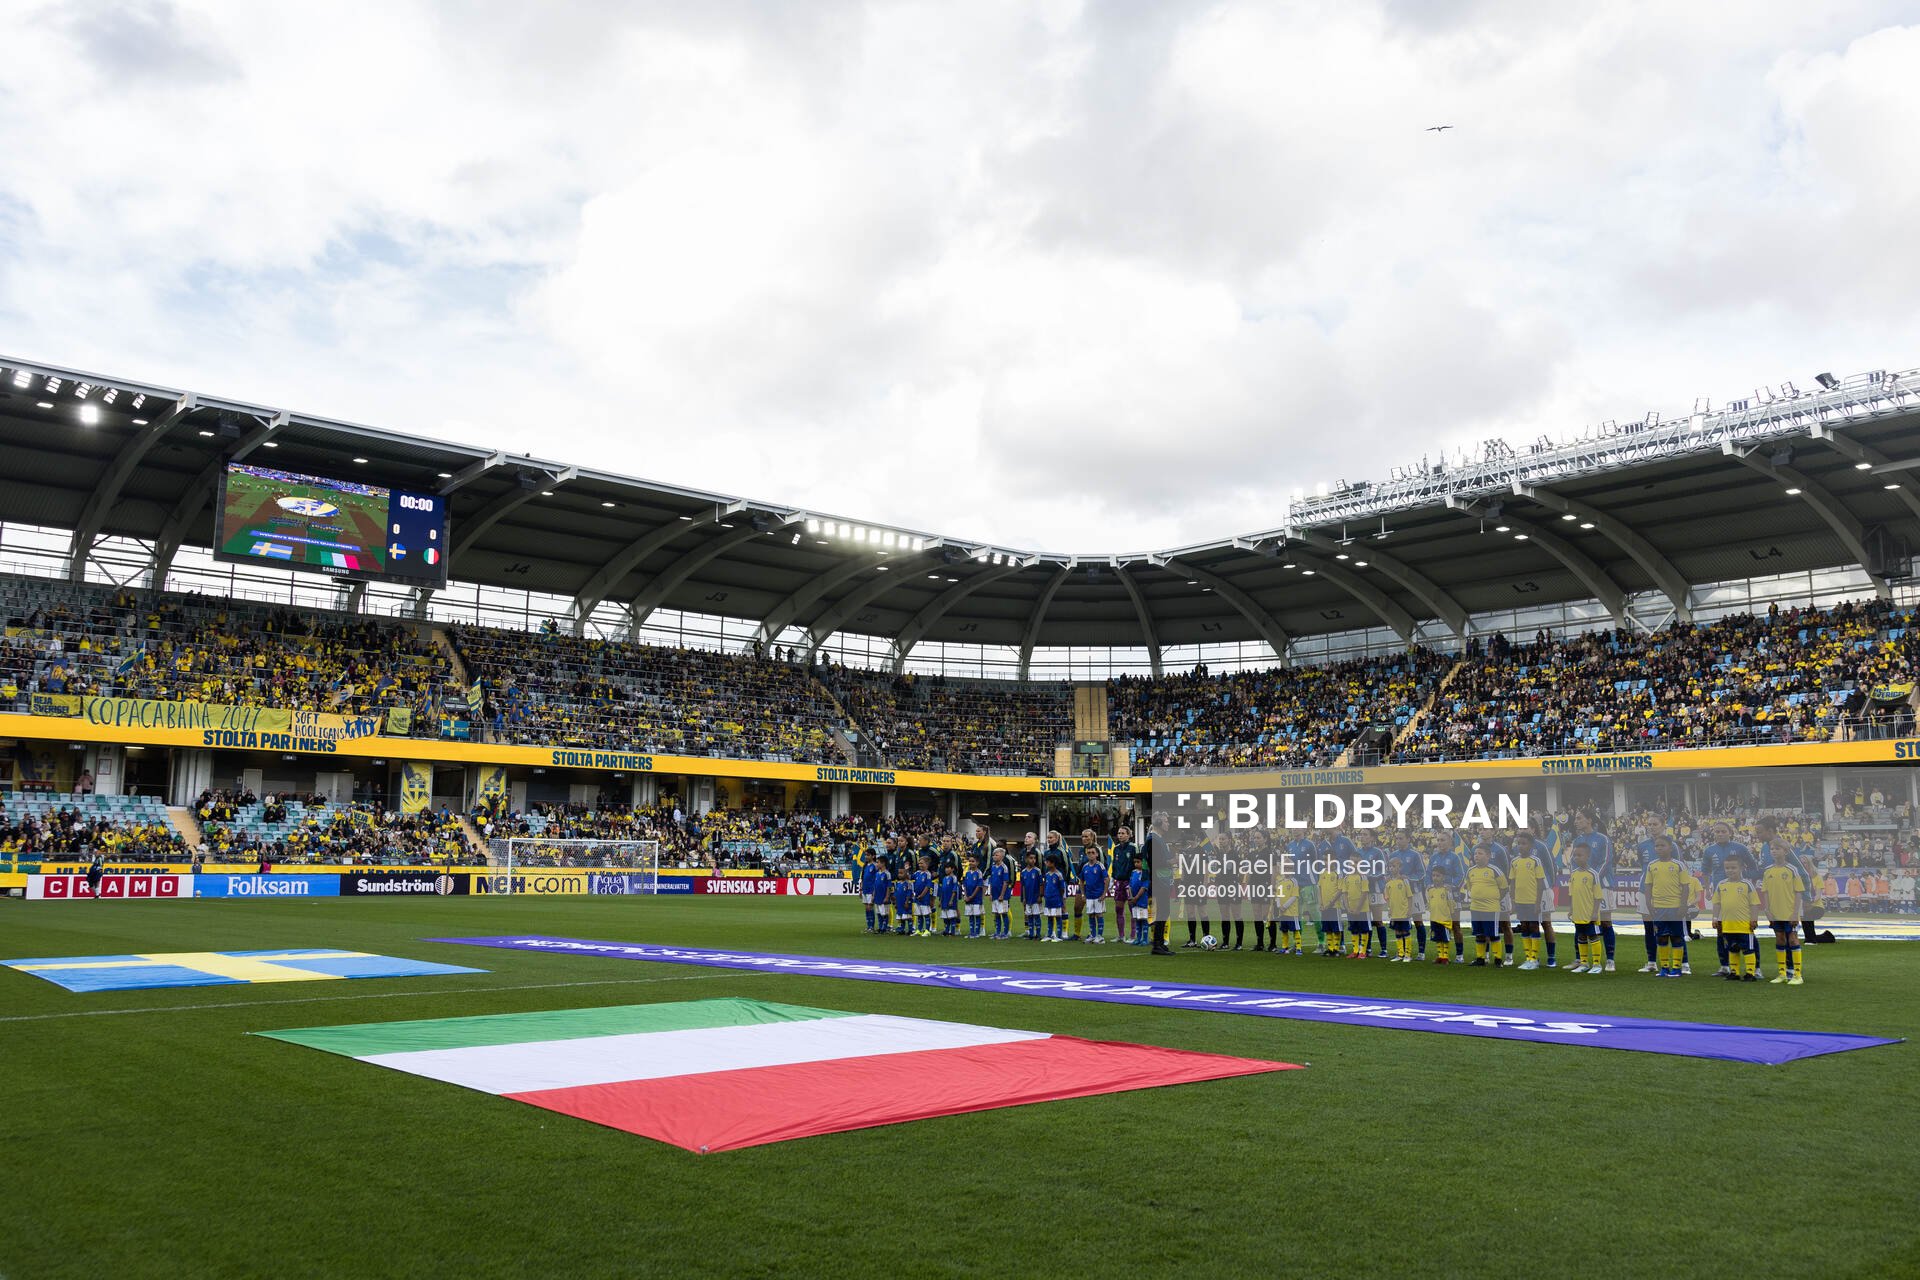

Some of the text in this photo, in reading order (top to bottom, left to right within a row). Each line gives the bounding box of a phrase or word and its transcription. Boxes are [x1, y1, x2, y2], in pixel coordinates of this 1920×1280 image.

[400, 495, 433, 512] 00:00
[393, 524, 400, 534] 0
[430, 529, 437, 540] 0
[1750, 547, 1783, 561] L4
[322, 566, 350, 575] SAMSUNG
[504, 563, 530, 575] J4
[1512, 581, 1540, 594] L3
[1320, 609, 1345, 621] L2
[1201, 622, 1223, 632] L1
[34, 695, 53, 705] HEJA
[88, 698, 262, 732] COPACABANA 2027
[295, 711, 320, 725] SOFT
[295, 724, 345, 740] HOOLIGANS
[203, 729, 337, 752] STOLTA PARTNERS
[552, 750, 653, 770] STOLTA PARTNERS
[1541, 755, 1653, 774] STOLTA PARTNERS
[816, 767, 895, 784] STOLTA PARTNERS
[1280, 770, 1364, 787] STOLTA PARTNERS
[1040, 779, 1131, 792] STOLTA PARTNERS
[50, 880, 174, 894] CRAMO
[227, 876, 309, 895] Folksam
[357, 878, 434, 893] Sundström
[706, 880, 755, 894] SVENSKA
[1002, 979, 1613, 1034] QUALIFIERS
